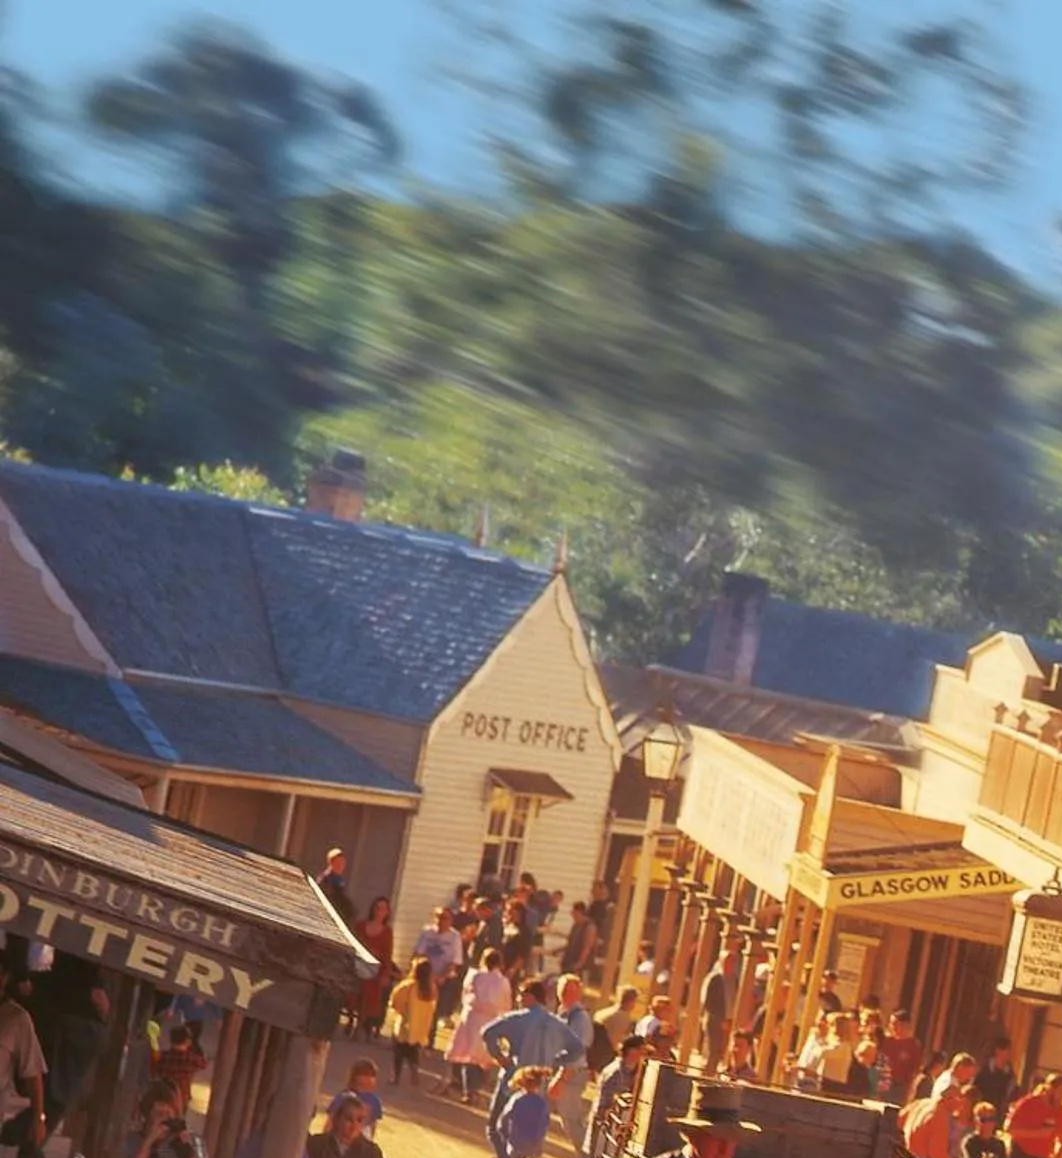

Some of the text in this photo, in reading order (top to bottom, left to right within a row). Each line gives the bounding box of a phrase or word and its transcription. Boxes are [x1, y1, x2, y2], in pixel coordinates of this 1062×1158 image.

[461, 711, 589, 752] POST OFFICE
[840, 875, 950, 900] GLASGOW
